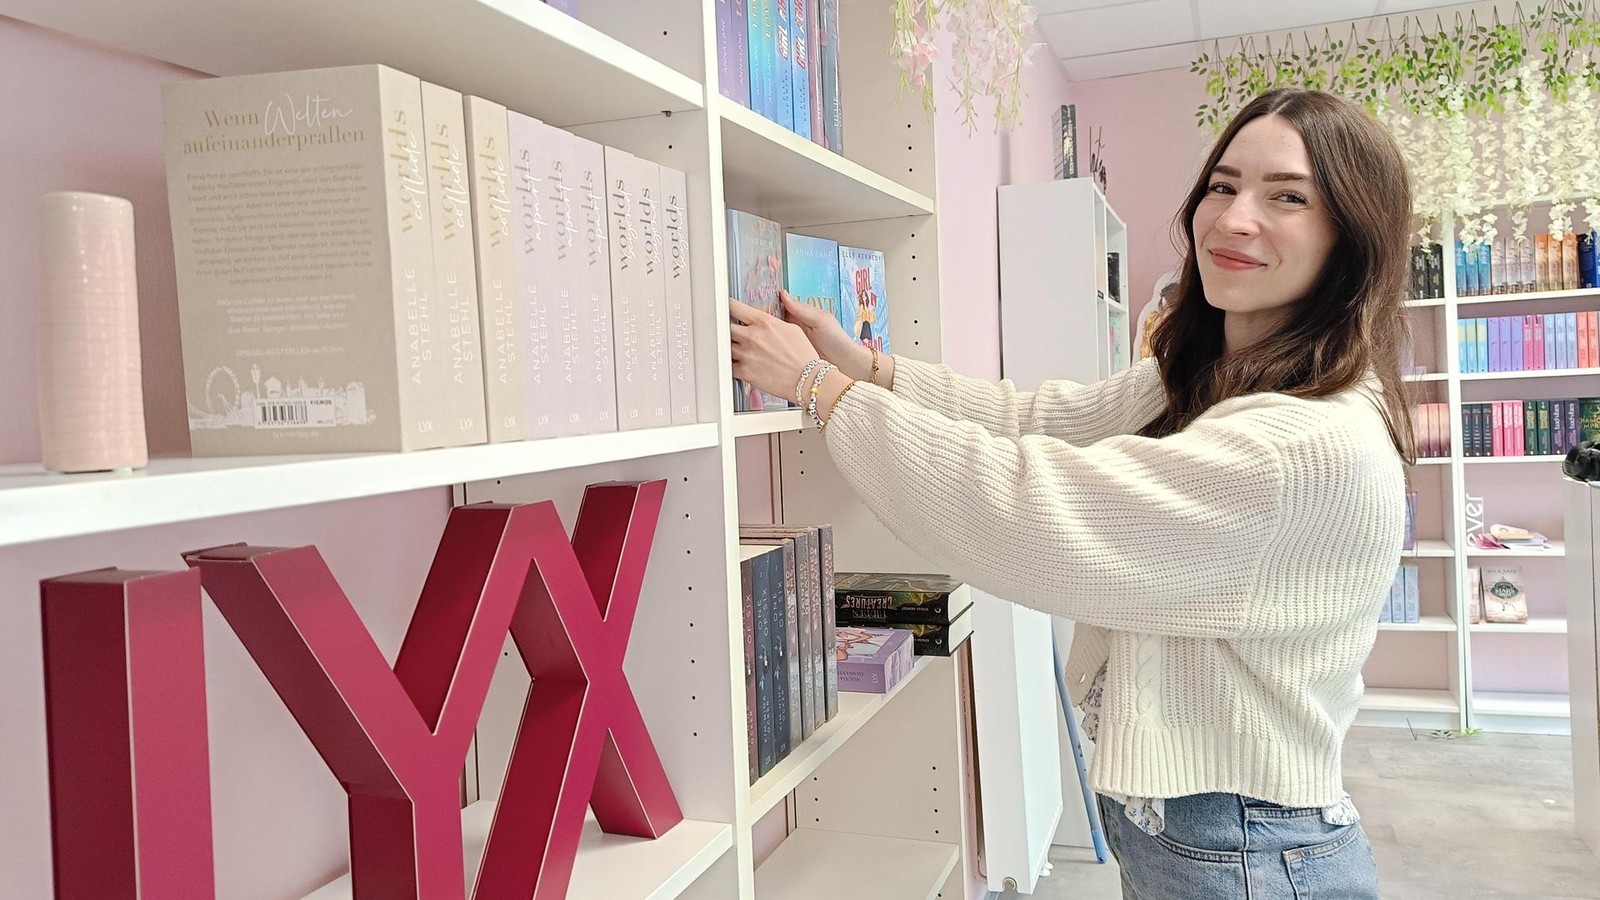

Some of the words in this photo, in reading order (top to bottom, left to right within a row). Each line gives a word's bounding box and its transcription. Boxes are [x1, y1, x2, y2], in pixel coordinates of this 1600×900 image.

[184, 125, 365, 153] aufeinanderprallen
[203, 110, 259, 128] Wenn
[264, 92, 354, 136] Welten
[431, 122, 456, 240] worlds
[515, 149, 534, 254] worlds
[548, 160, 566, 261] worlds
[580, 170, 596, 266] worlds
[613, 179, 628, 271] worlds
[639, 188, 653, 275] worlds
[666, 195, 681, 279] worlds
[794, 248, 814, 257] ANNA
[816, 250, 833, 259] LANE
[857, 252, 881, 262] KENNEDY
[856, 267, 873, 294] GIRL
[405, 267, 422, 384] ANABELLE
[419, 292, 432, 361] STEHL
[447, 273, 464, 384] ANABELLE
[461, 297, 473, 362] STEHL
[493, 278, 510, 384] ANABELLE
[504, 301, 516, 363] STEHL
[528, 283, 542, 384] ANABELLE
[539, 305, 550, 363] STEHL
[560, 288, 573, 384] ANABELLE
[570, 308, 580, 365] STEHL
[591, 292, 603, 384] ANABELLE
[600, 311, 609, 365] STEHL
[621, 296, 633, 382] ANABELLE
[630, 314, 639, 365] STEHL
[647, 298, 658, 382] ANABELLE
[655, 316, 664, 365] STEHL
[674, 303, 685, 382] ANABELLE
[682, 318, 690, 365] STEHL
[846, 595, 892, 610] CREATURES
[852, 608, 887, 620] HIDDEN
